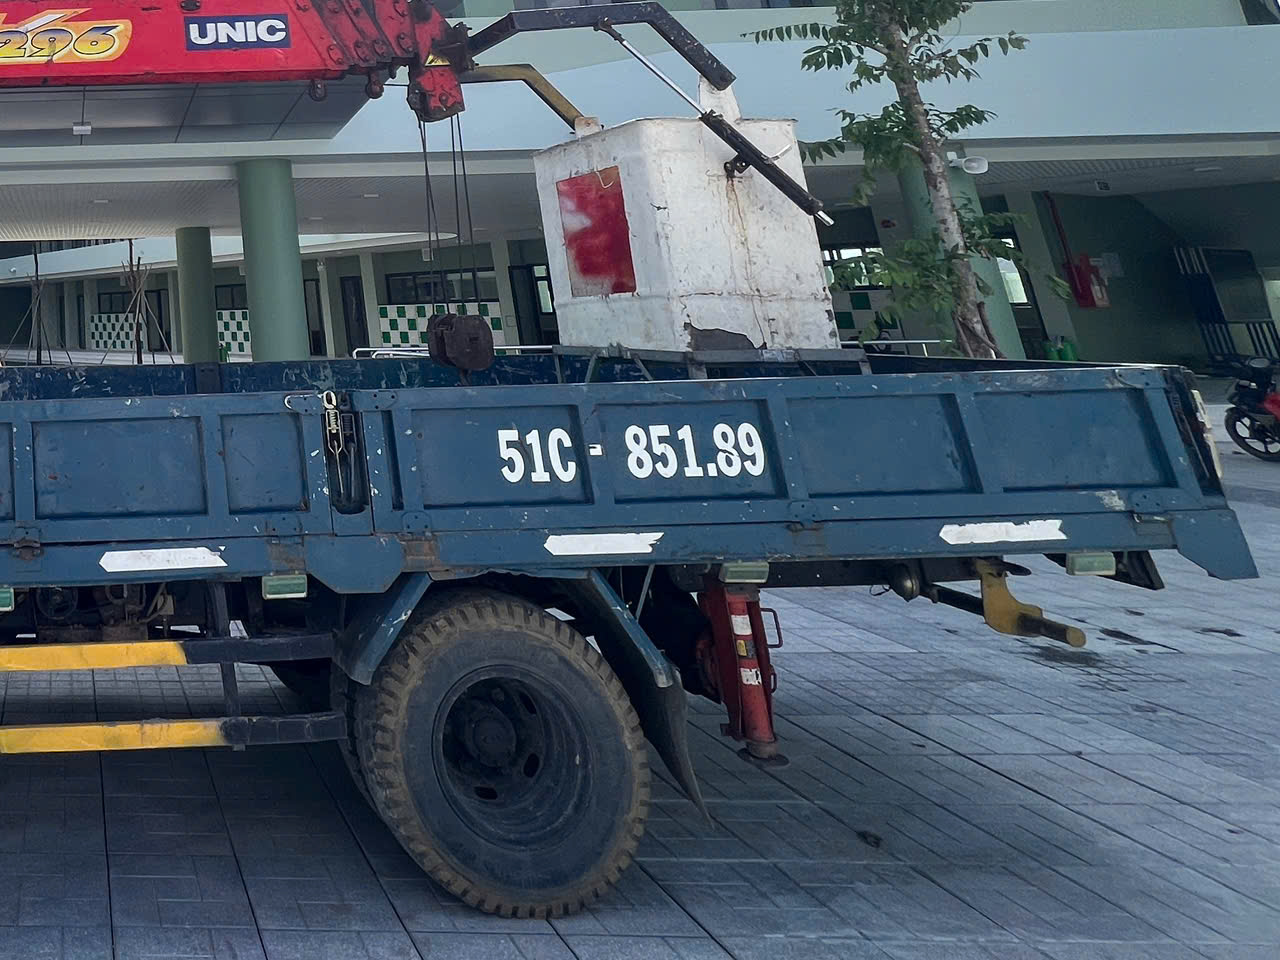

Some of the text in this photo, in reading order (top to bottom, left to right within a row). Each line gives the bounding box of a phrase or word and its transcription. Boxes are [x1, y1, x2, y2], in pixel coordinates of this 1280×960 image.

[189, 19, 287, 45] UNIC
[497, 428, 576, 483] 51C
[624, 422, 765, 479] 851.89
